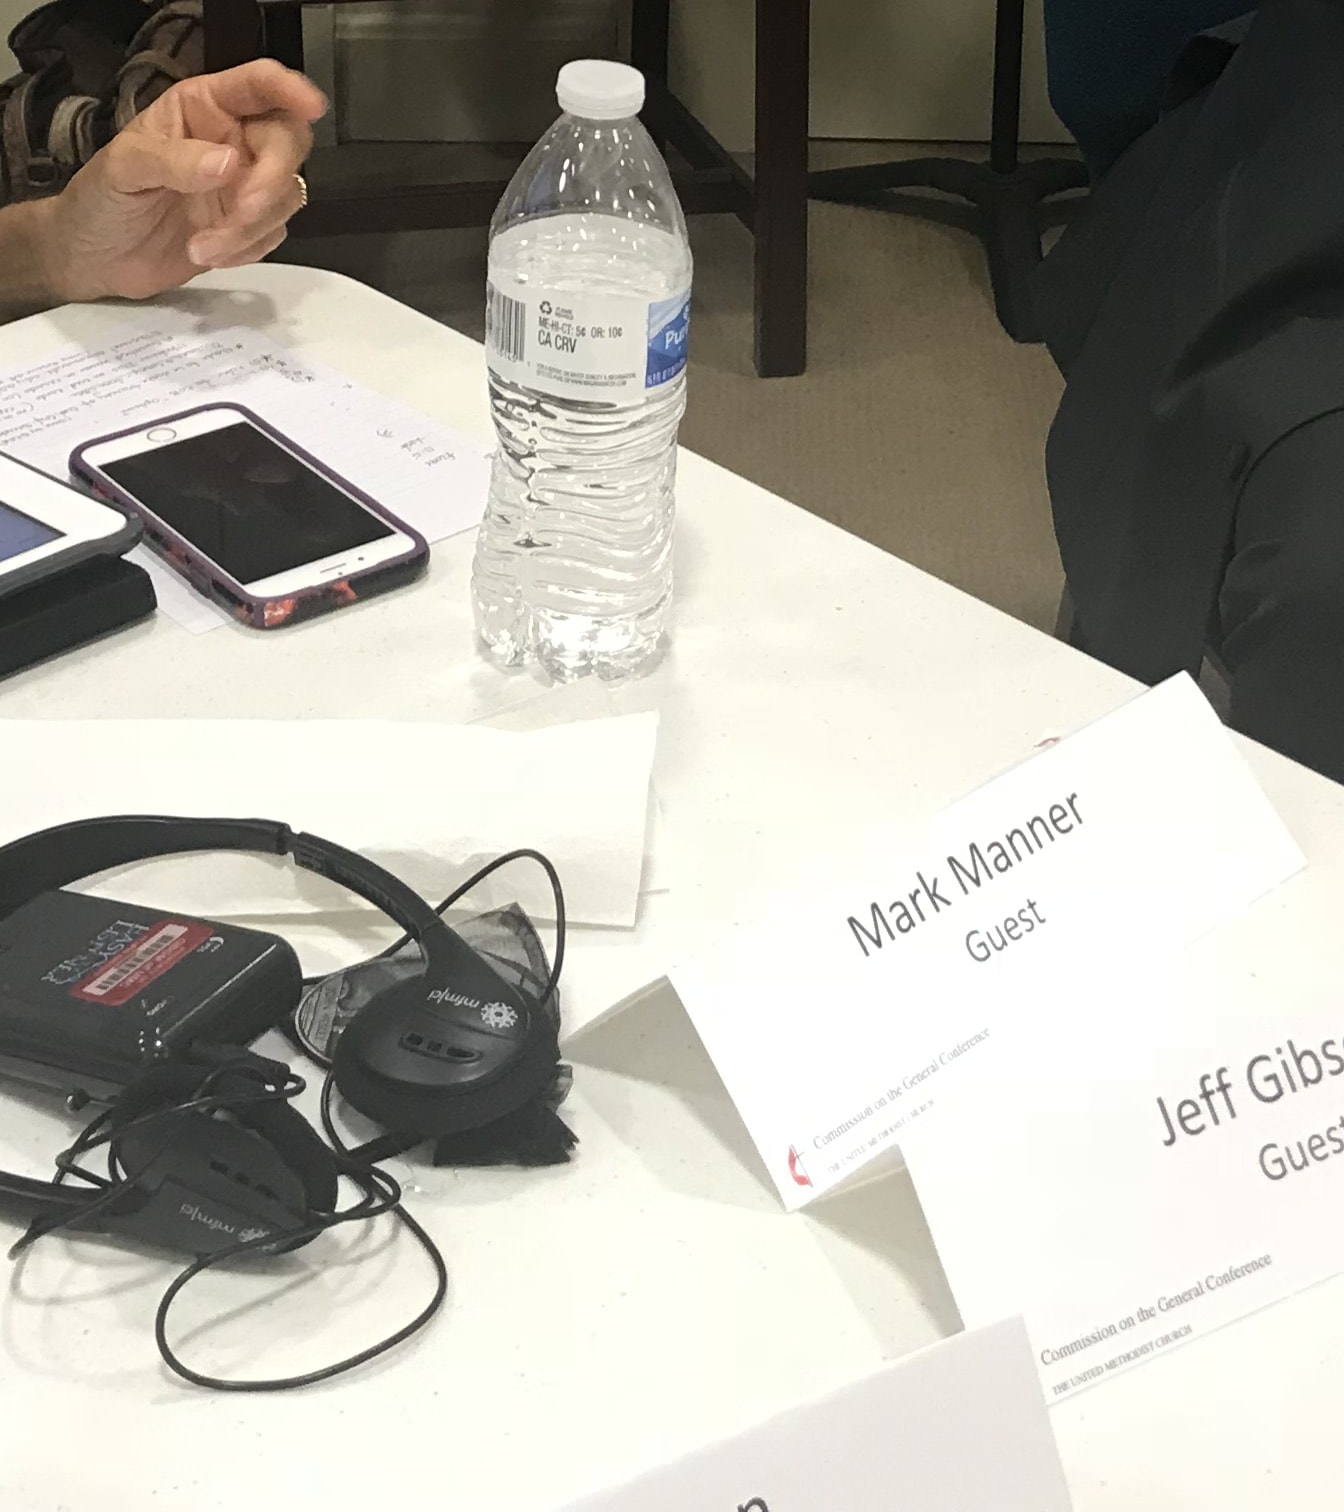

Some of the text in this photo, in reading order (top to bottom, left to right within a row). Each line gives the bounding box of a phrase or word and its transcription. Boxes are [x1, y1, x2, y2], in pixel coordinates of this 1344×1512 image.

[538, 329, 577, 353] CA CRV
[847, 792, 1083, 957] Mark Manner
[965, 899, 1047, 962] Guest
[813, 1028, 990, 1150] Commission on the General Conference
[1156, 1067, 1237, 1147] Jeff
[1040, 1253, 1272, 1366] Commission on the General Conference
[1052, 1378, 1071, 1395] THE
[1070, 1365, 1104, 1387] UNITED
